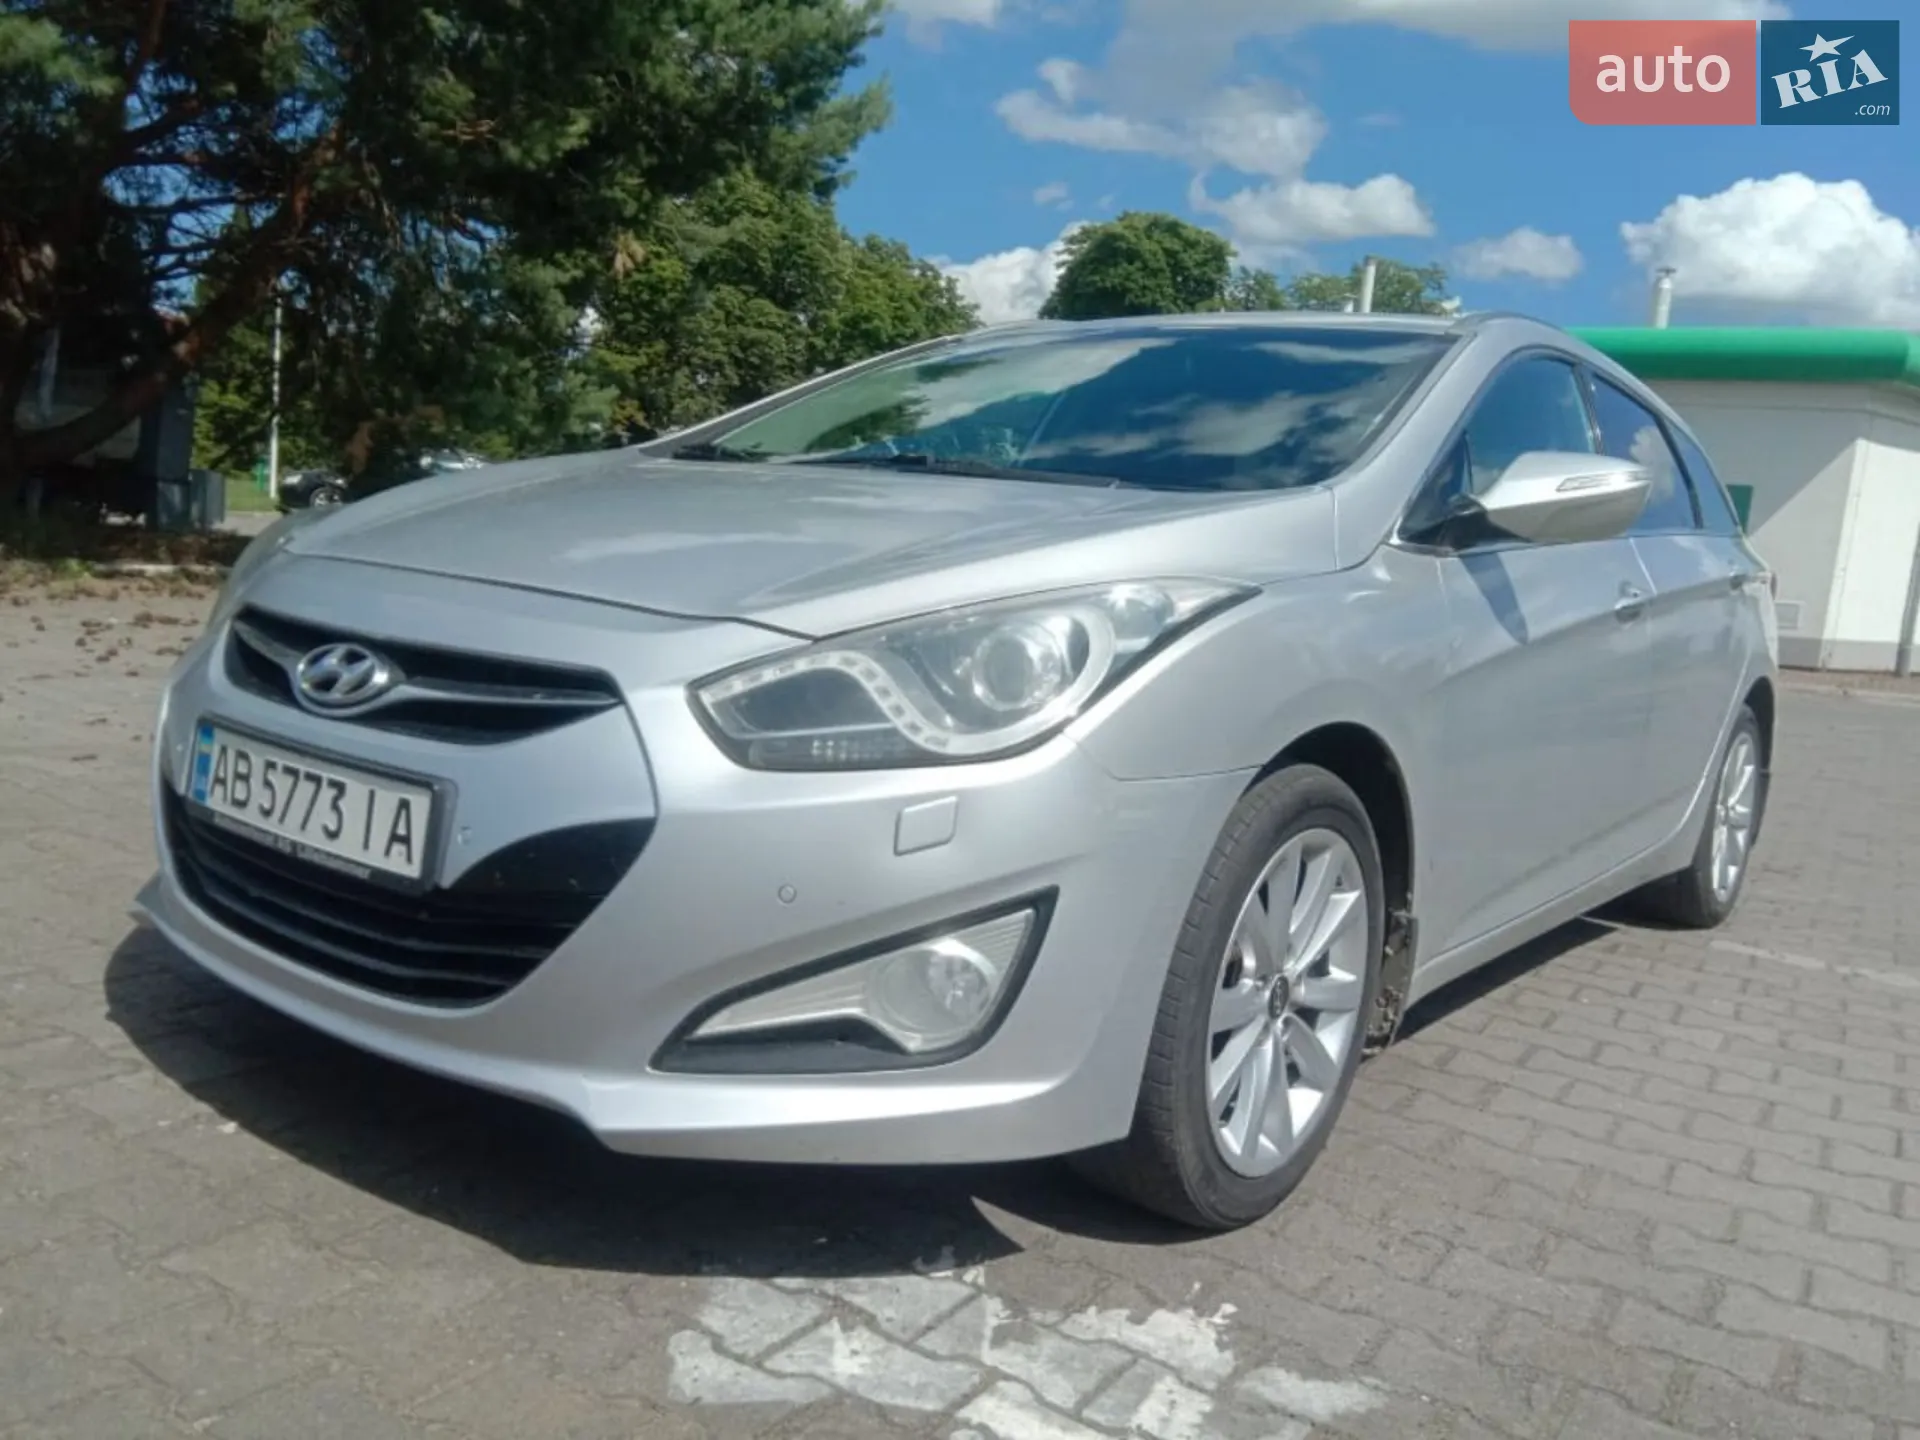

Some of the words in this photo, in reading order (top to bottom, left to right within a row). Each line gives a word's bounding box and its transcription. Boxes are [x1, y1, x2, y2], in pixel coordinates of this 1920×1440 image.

[210, 744, 252, 809] AB
[258, 759, 347, 841] 5773
[363, 788, 413, 865] IA
